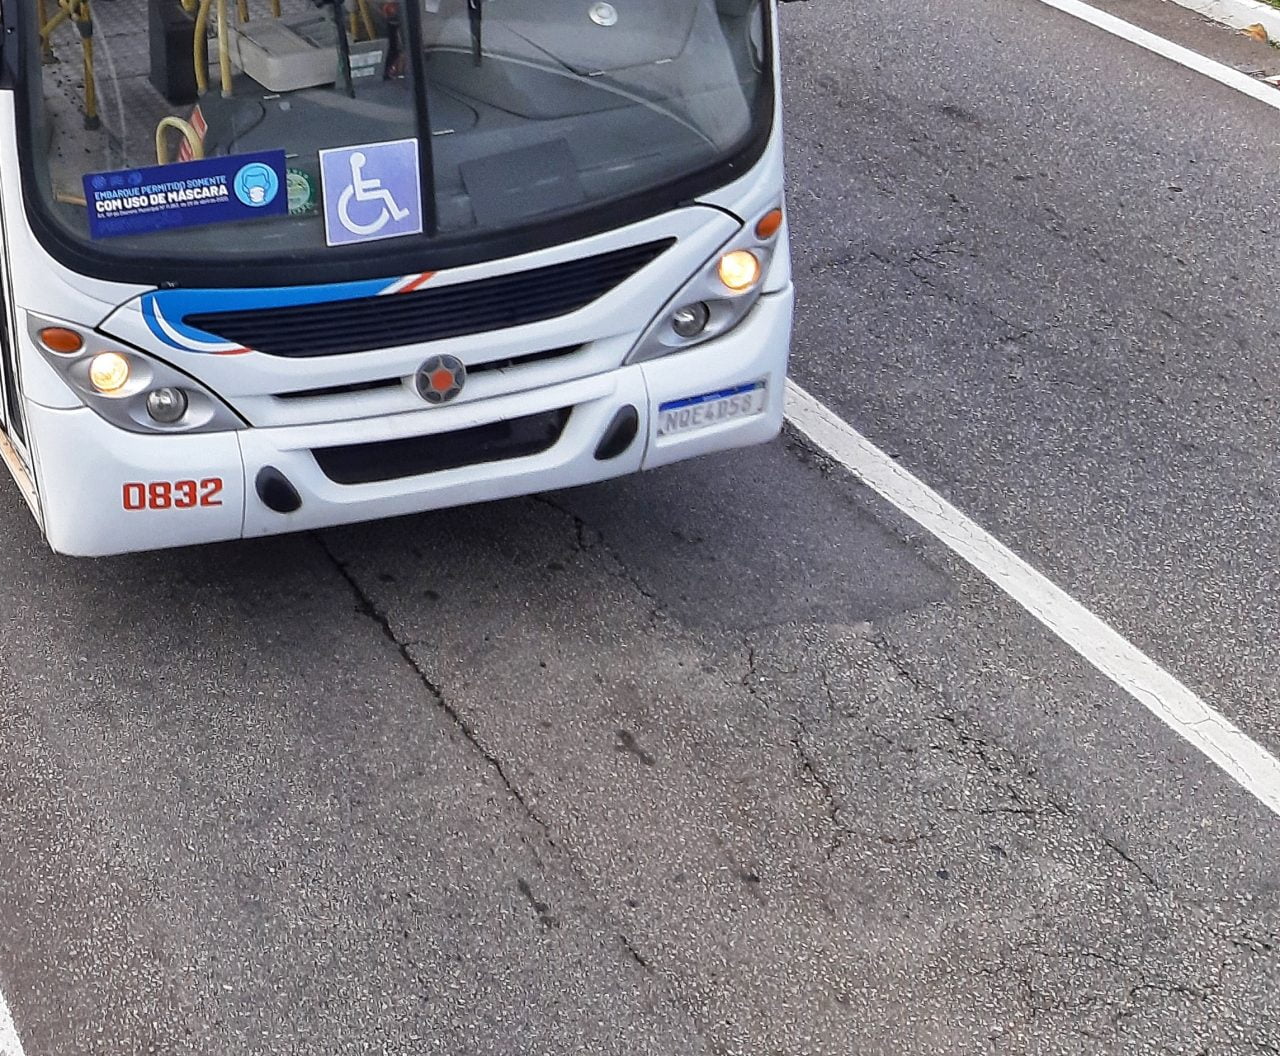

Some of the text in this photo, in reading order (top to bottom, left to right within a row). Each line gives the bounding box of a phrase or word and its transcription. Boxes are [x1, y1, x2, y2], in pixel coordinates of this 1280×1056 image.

[94, 175, 227, 200] EMBARQUE PERMITIDO SOMENTE
[95, 198, 123, 213] COM
[123, 194, 149, 209] USO
[149, 191, 167, 206] DE
[166, 183, 229, 203] MÁSCARA
[122, 477, 223, 510] 0832
